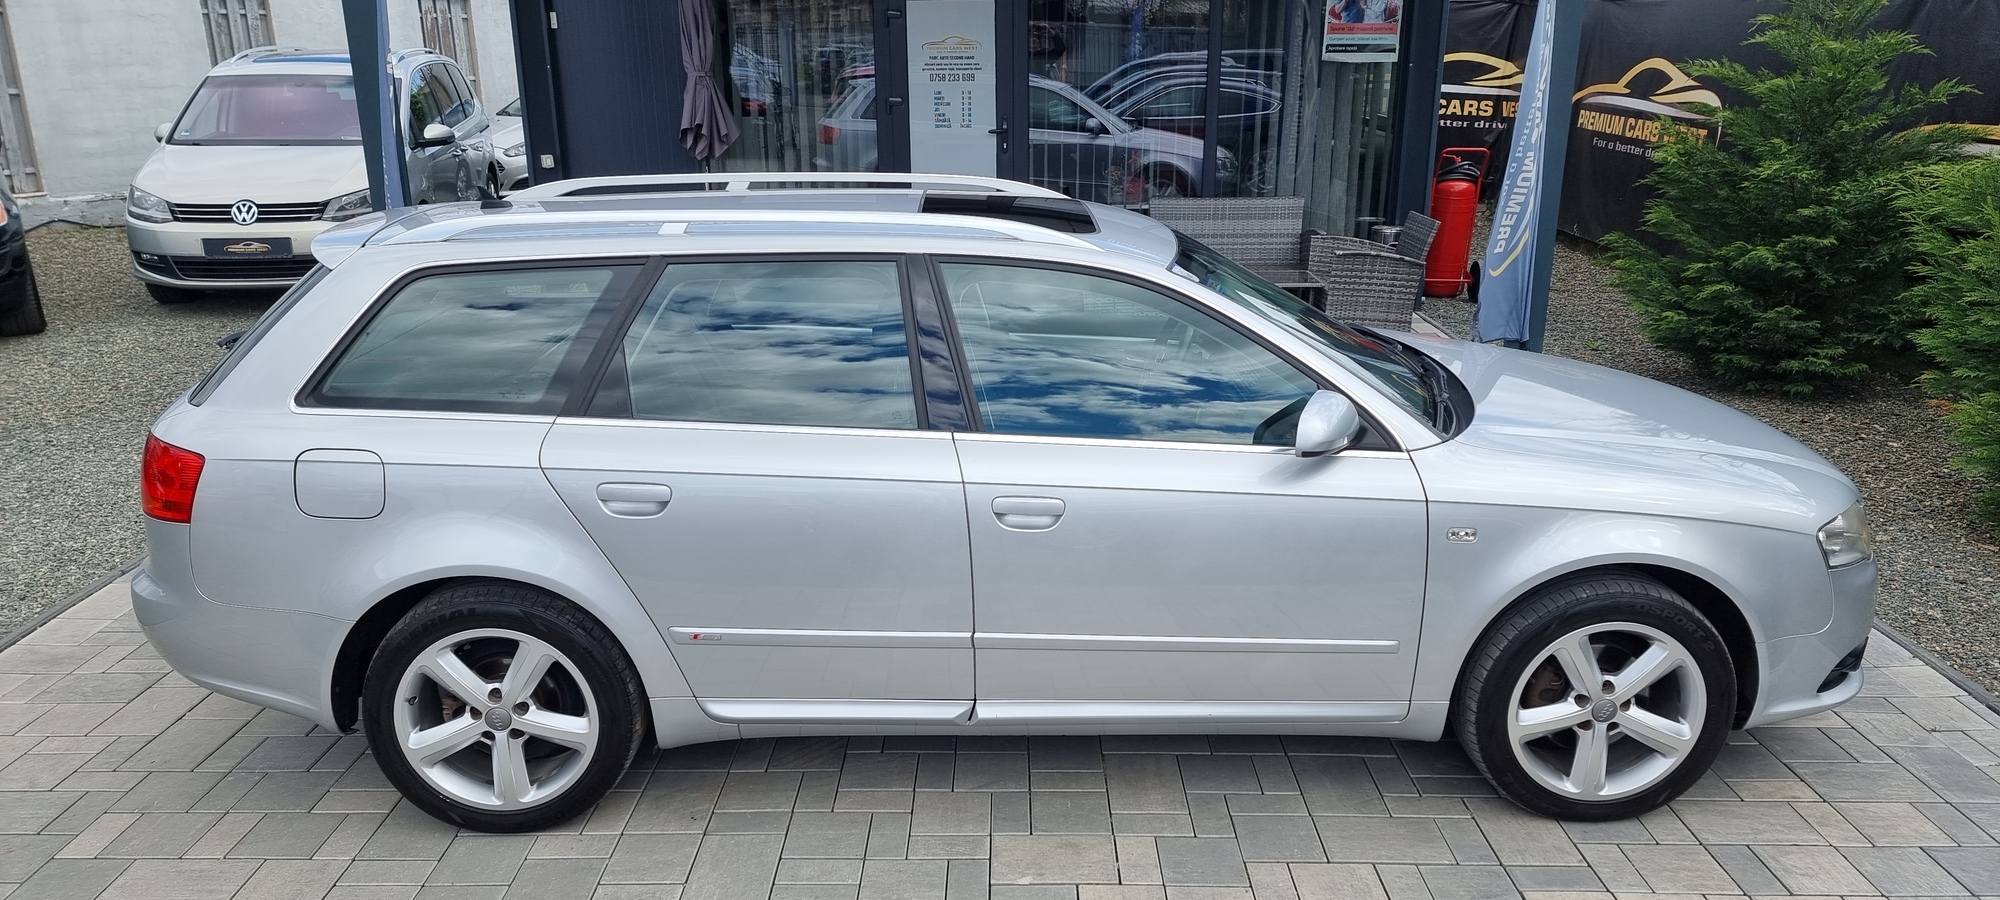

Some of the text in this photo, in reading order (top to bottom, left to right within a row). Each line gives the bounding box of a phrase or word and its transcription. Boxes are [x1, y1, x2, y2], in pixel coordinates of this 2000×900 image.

[929, 73, 976, 82] 0758 233 699
[1438, 98, 1494, 117] CARS
[1438, 119, 1508, 129] tter driv
[1577, 109, 1626, 136] PREMIUM
[1625, 117, 1661, 143] CARS
[1593, 137, 1607, 148] For
[1608, 142, 1614, 150] a
[1616, 141, 1644, 156] better
[231, 200, 258, 226] VW
